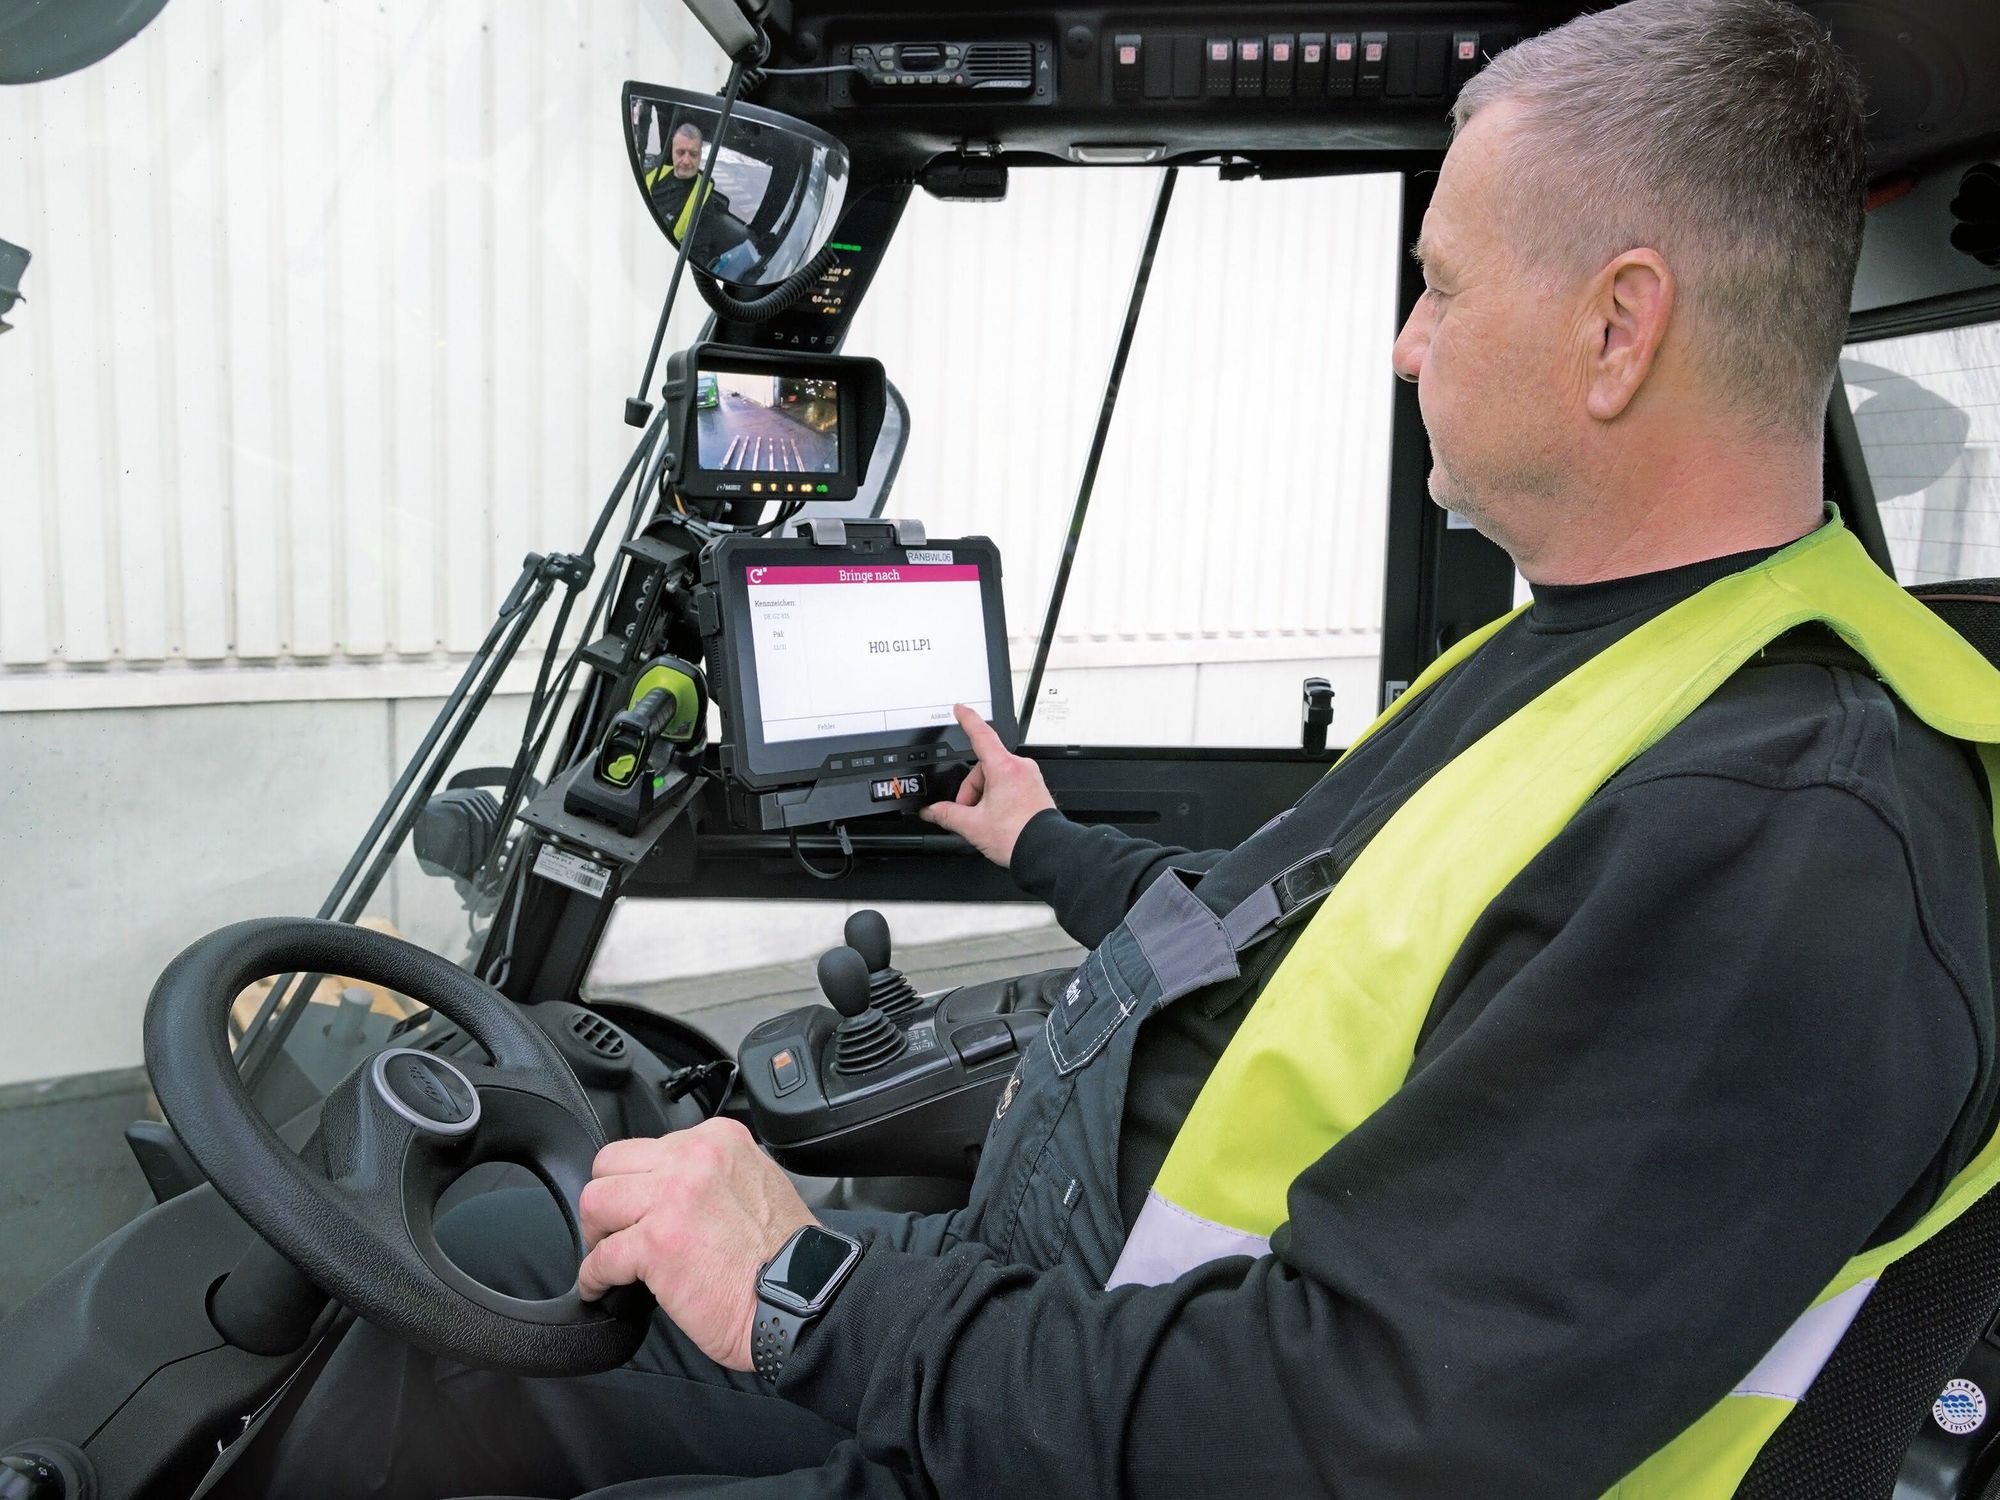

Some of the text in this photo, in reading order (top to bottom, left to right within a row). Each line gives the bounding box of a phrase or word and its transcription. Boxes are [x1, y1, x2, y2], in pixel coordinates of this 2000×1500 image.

[1040, 60, 1048, 70] A
[907, 552, 952, 562] RANBWL06
[839, 569, 900, 583] Bringe nach
[869, 640, 890, 653] H01
[912, 638, 931, 651] LP1
[877, 777, 919, 797] HAVIS
[1935, 1404, 1977, 1431] KLIMA SYSTEM
